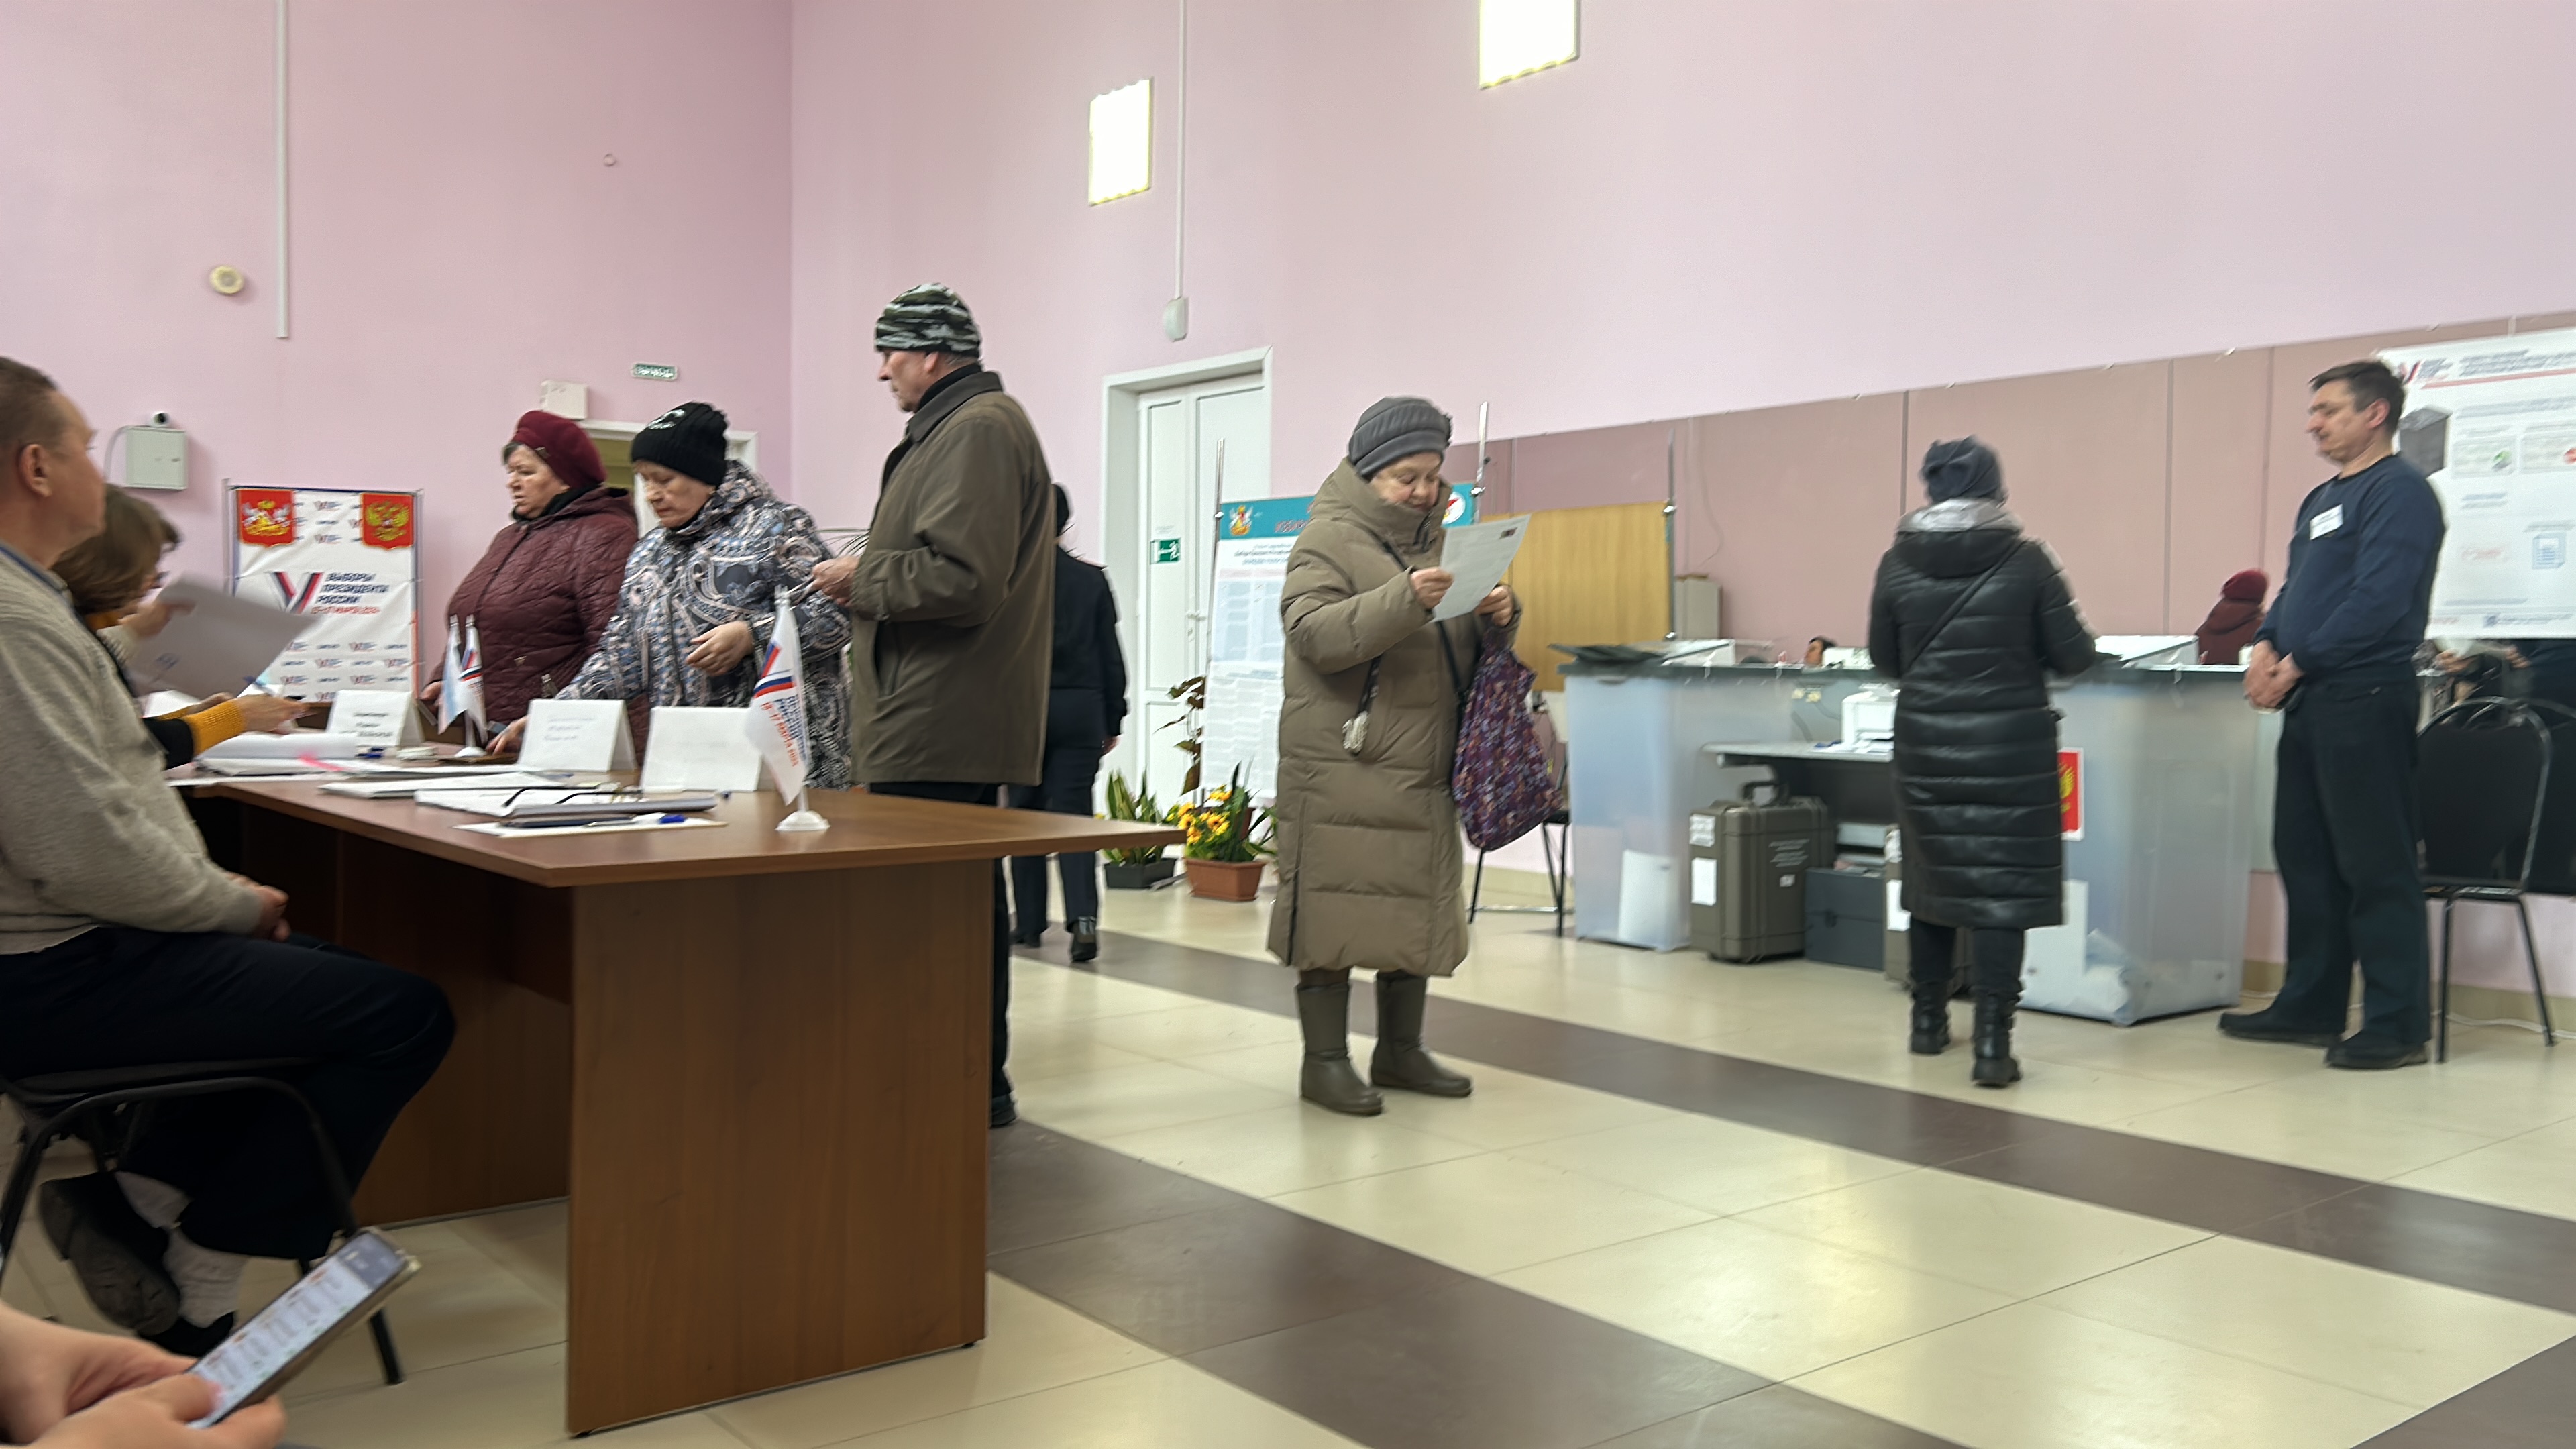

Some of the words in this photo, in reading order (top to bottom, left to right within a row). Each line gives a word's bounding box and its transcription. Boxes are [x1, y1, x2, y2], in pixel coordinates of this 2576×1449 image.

[325, 572, 377, 582] ВЫБОРЫ
[320, 584, 390, 594] ПРЕЗИДЕНТА
[315, 594, 362, 604] РОССИИ
